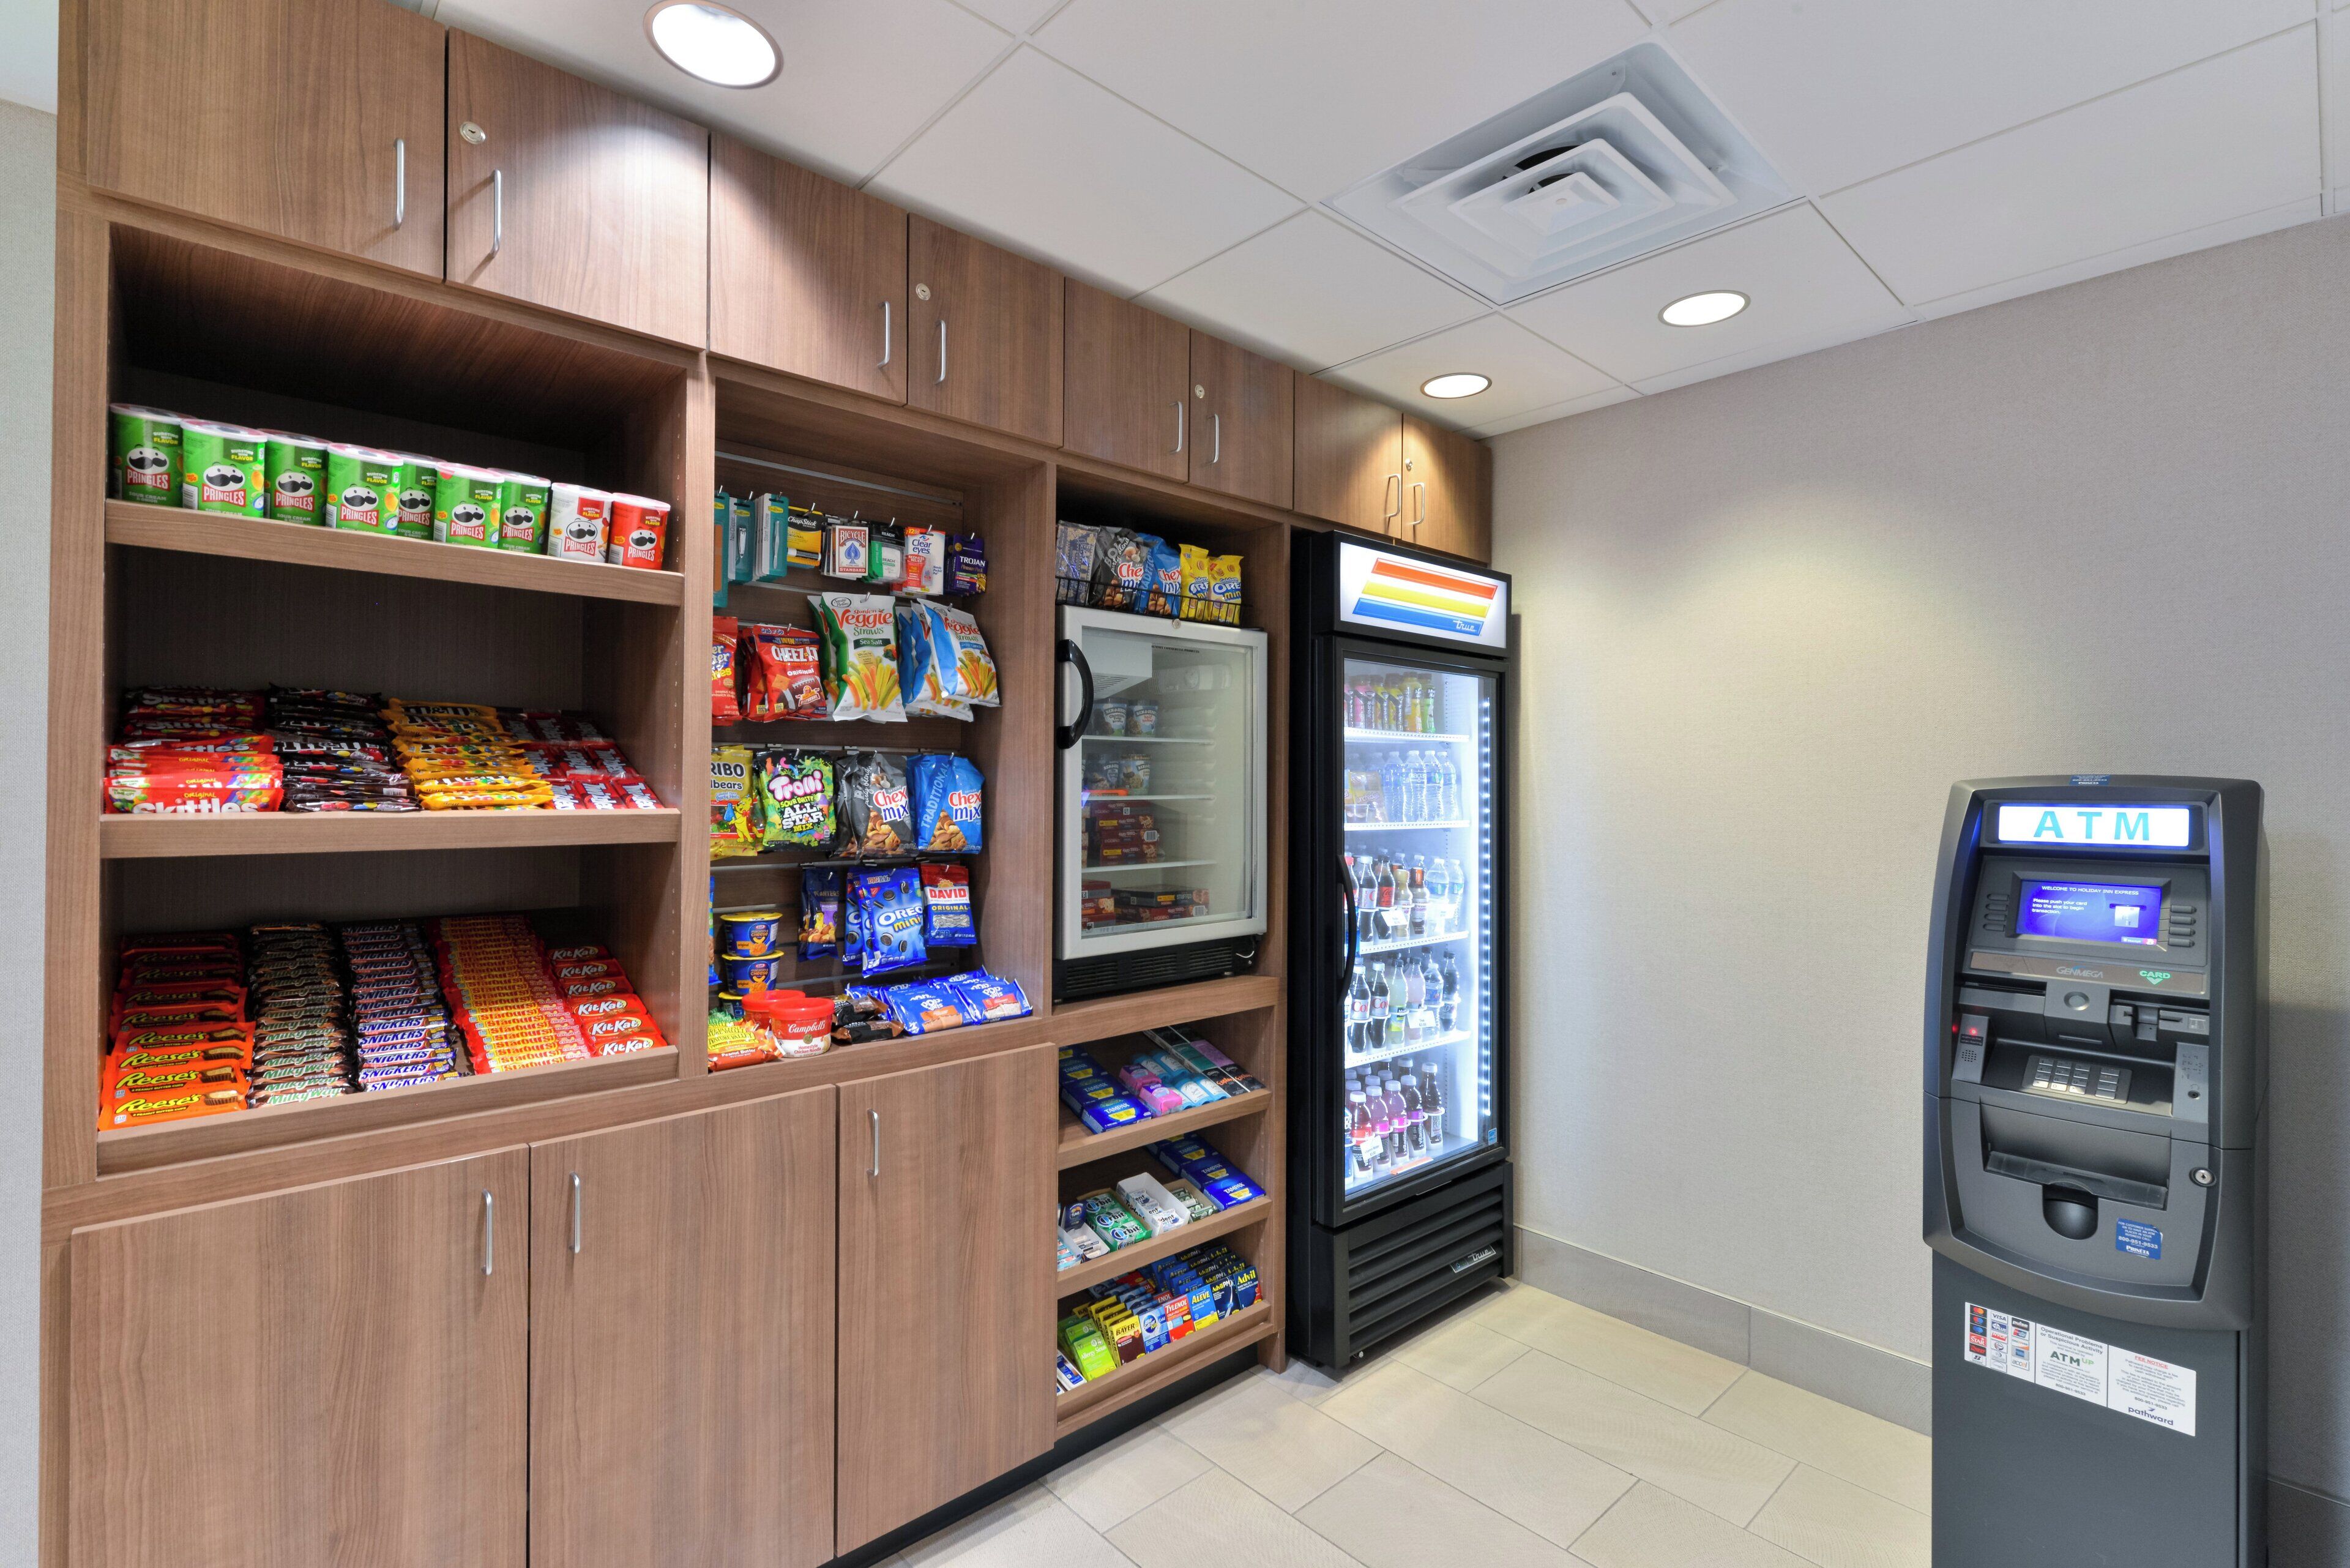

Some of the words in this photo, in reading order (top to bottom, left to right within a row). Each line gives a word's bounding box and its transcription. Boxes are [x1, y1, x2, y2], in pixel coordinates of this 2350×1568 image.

[127, 467, 169, 490] PRINGLES
[203, 485, 245, 506] PRINGLES
[275, 492, 313, 511] PRINGLES
[340, 507, 378, 525] PRINGLES
[398, 509, 431, 525] PRINGLES
[788, 515, 817, 527] ChapStick
[450, 521, 484, 540] PRINGLES
[502, 524, 534, 542] PRINGLES
[840, 530, 865, 546] BICYCLE
[565, 539, 595, 555] PRINGLES
[912, 539, 932, 548] Clear
[627, 547, 655, 562] PRINGLES
[960, 556, 985, 567] TROJAN
[831, 608, 895, 630] Veggie
[943, 616, 980, 635] Veggie
[1453, 619, 1475, 632] true
[853, 627, 884, 636] Straws
[771, 645, 819, 662] CHEEZ-IT
[769, 770, 824, 801] Trolli
[873, 786, 908, 807] Chex
[921, 763, 949, 828] TRADITIONAL
[949, 791, 982, 807] Chex
[780, 799, 797, 808] SOUR
[783, 803, 820, 818] ALL
[882, 801, 909, 822] mix
[954, 805, 981, 822] mix
[782, 812, 825, 829] STAR
[793, 824, 814, 832] MIX
[2034, 810, 2149, 841] ATM
[929, 888, 967, 899] DAVID
[2056, 966, 2103, 979] GENMEGA
[2139, 970, 2171, 980] CARD
[357, 987, 419, 1000] SNICKERS
[121, 1012, 197, 1025] Reese's
[480, 1009, 539, 1020] Starburst
[487, 1015, 546, 1027] Starburst
[359, 1017, 423, 1032] SNICKERS
[490, 1021, 550, 1034] Starburst
[788, 1020, 826, 1034] Campbell's
[128, 1031, 207, 1045] Reese's
[359, 1029, 424, 1045] SNICKERS
[494, 1028, 555, 1041] Starburst
[496, 1036, 556, 1048] Starburst
[731, 1032, 753, 1041] VALLEY
[497, 1042, 559, 1056] Starburst
[501, 1050, 561, 1062] Starburst
[119, 1049, 202, 1068] Reese's
[115, 1070, 199, 1089] Reese's
[361, 1064, 429, 1080] SNICKERS
[370, 1077, 436, 1092] SNICKERS
[1084, 1082, 1108, 1092] TAMPAX
[115, 1094, 202, 1114] Reese's
[1104, 1102, 1130, 1114] TAMPAX
[1179, 1145, 1199, 1154] TAMPAX
[1201, 1163, 1223, 1174] TAMPAX
[1223, 1182, 1245, 1194] TAMPAX
[1086, 1197, 1113, 1213] Orbit
[1126, 1198, 1145, 1220] Trident
[1096, 1211, 1126, 1228] Orbit
[1110, 1224, 1141, 1242] Orbit
[2118, 1236, 2158, 1249] 800-951-9533
[1237, 1269, 1256, 1285] Advil
[1192, 1290, 1210, 1304] ALEVE
[1165, 1299, 1188, 1314] TYLENOL
[1116, 1323, 1135, 1336] BAYER
[1971, 1336, 1985, 1345] STAR
[2040, 1327, 2073, 1340] Operational
[2075, 1337, 2103, 1349] Problems
[2048, 1334, 2080, 1347] Suspicious
[2081, 1344, 2103, 1355] Activity
[1081, 1351, 1095, 1360] Allergy
[2050, 1351, 2080, 1367] ATM
[2012, 1359, 2027, 1368] accel
[2147, 1359, 2168, 1369] NOTICE
[2135, 1397, 2167, 1410] 800-951-9533
[2128, 1407, 2174, 1425] pathward
